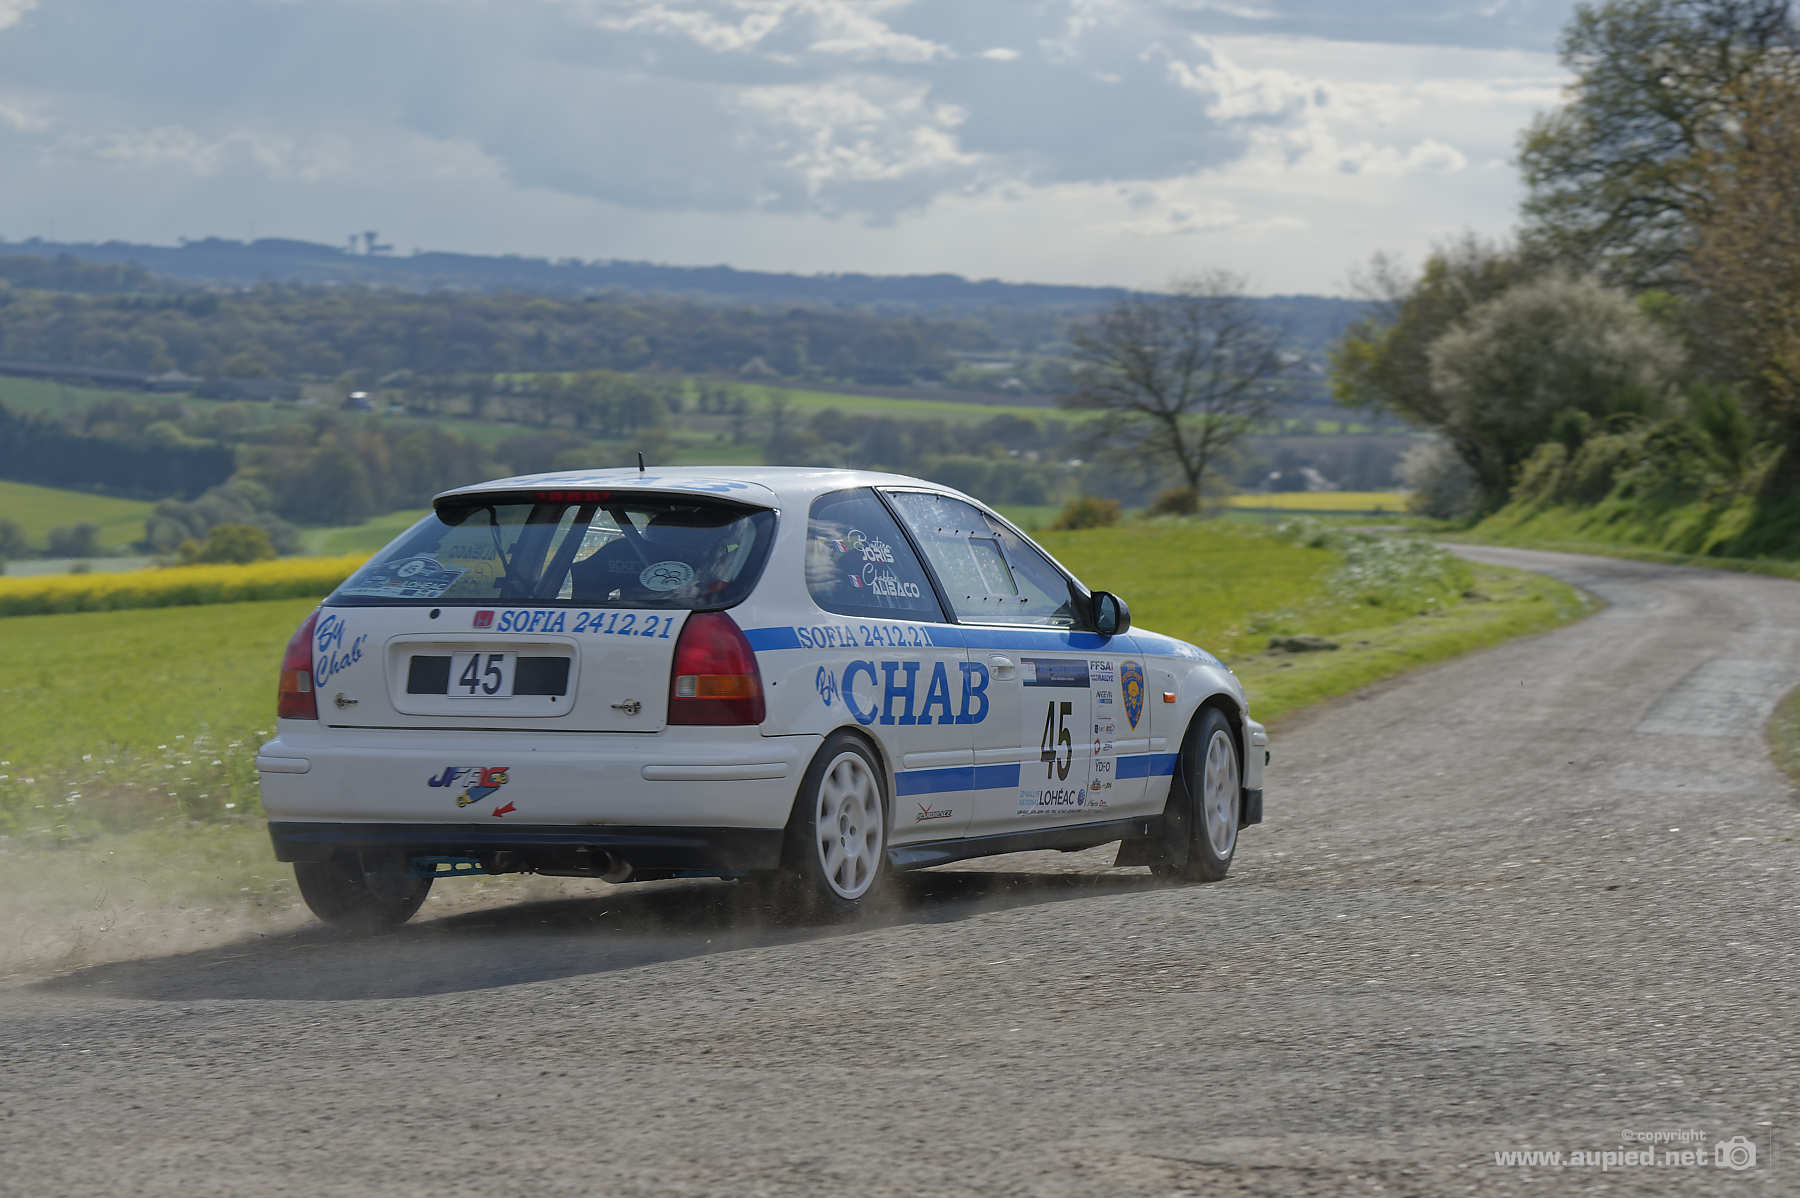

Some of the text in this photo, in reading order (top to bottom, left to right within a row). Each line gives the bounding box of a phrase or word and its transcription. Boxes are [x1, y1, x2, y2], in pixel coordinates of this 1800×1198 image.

[315, 614, 345, 652] By
[498, 610, 673, 640] SOFIA 2412.21
[798, 626, 932, 650] SOFIA 2412.21
[459, 652, 504, 695] 45
[841, 659, 991, 725] CHAB
[1040, 700, 1073, 781] 45
[1038, 787, 1076, 806] LOHÉAC
